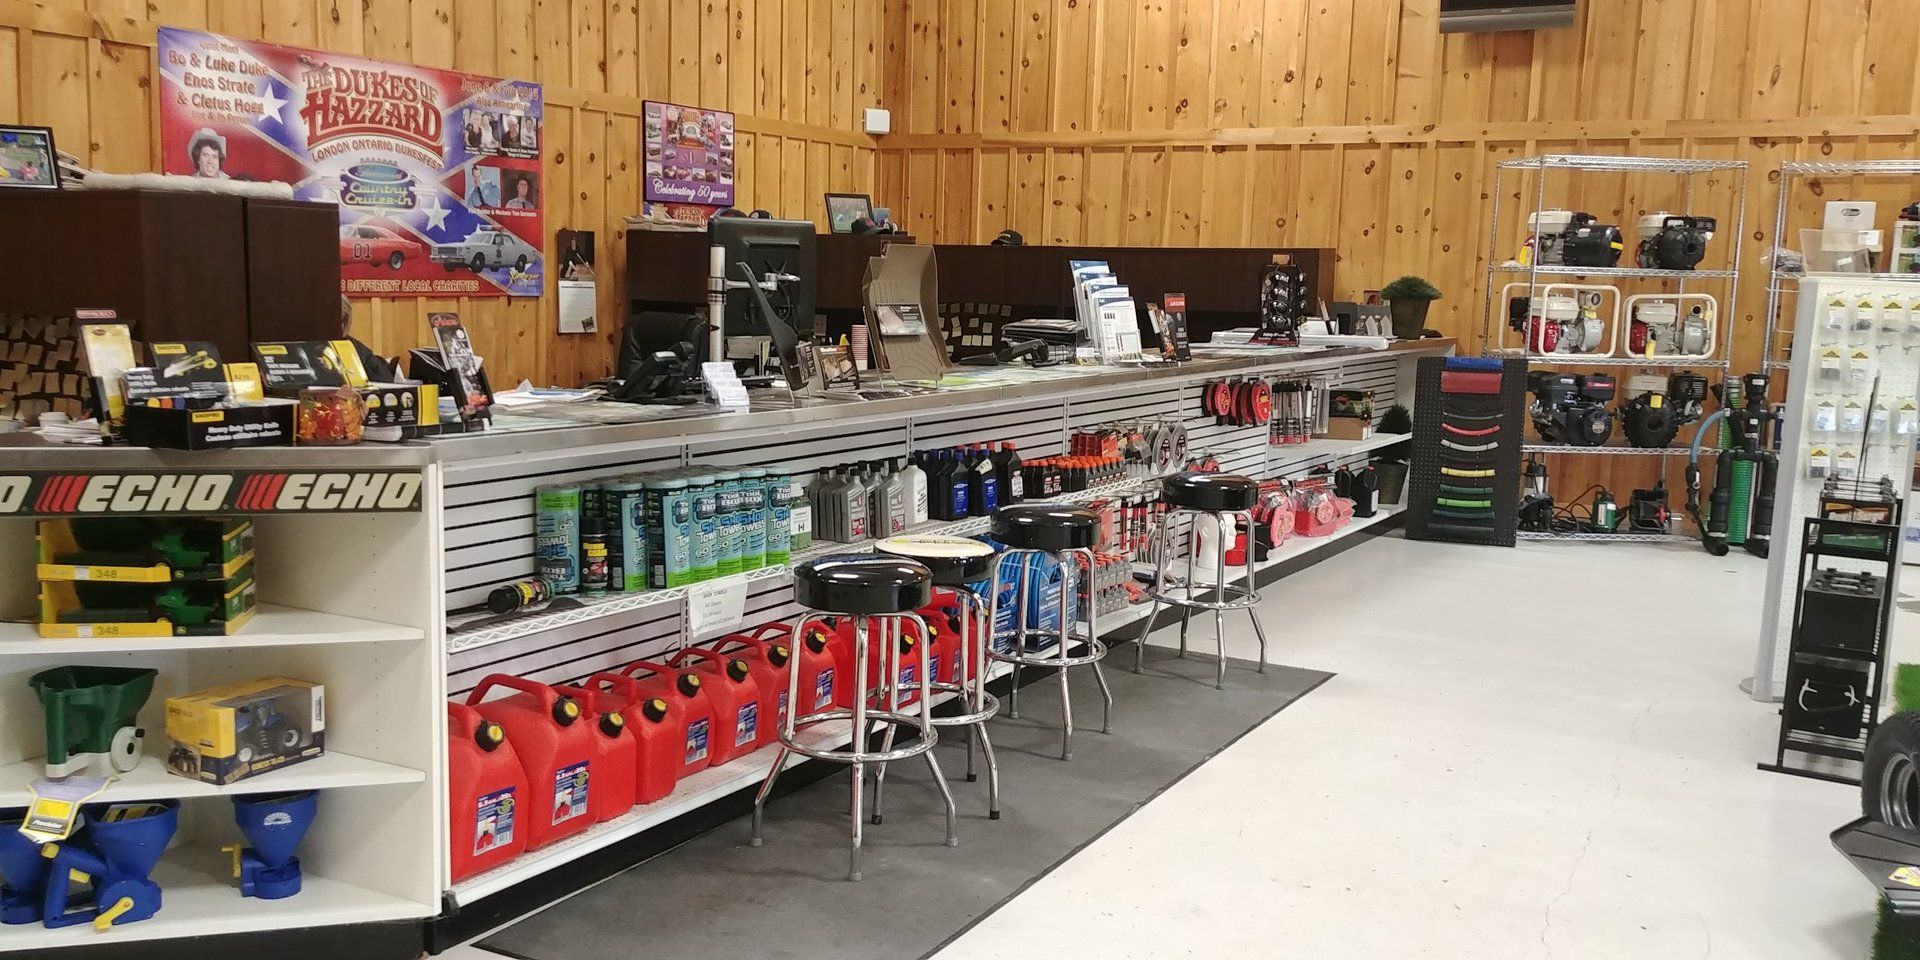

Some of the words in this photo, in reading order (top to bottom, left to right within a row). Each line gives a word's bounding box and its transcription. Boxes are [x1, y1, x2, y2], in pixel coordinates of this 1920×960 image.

[168, 49, 186, 66] Bo
[189, 53, 202, 69] &
[205, 55, 236, 73] Luke
[240, 60, 269, 77] Duke
[184, 72, 215, 91] Enos
[218, 76, 256, 95] Strate
[302, 70, 333, 91] THE
[332, 66, 418, 102] DUKES
[419, 81, 438, 103] OF
[461, 78, 481, 94] June
[177, 91, 188, 107] &
[192, 93, 231, 111] Cletus
[234, 98, 265, 116] Hogg
[300, 88, 443, 146] HAZZARD
[312, 140, 349, 163] LONDON
[352, 139, 393, 151] ONTARIO
[395, 143, 445, 170] DUKESFEST
[653, 178, 697, 202] Celebrating
[697, 185, 710, 198] 50
[710, 189, 728, 204] years
[353, 243, 372, 259] 01
[347, 279, 401, 293] DIFFERENT
[402, 280, 433, 292] LOCAL
[434, 279, 481, 293] CHARITIES
[78, 475, 233, 512] ECHO
[275, 473, 422, 510] ECHO
[96, 569, 118, 579] 348
[97, 626, 119, 636] 348
